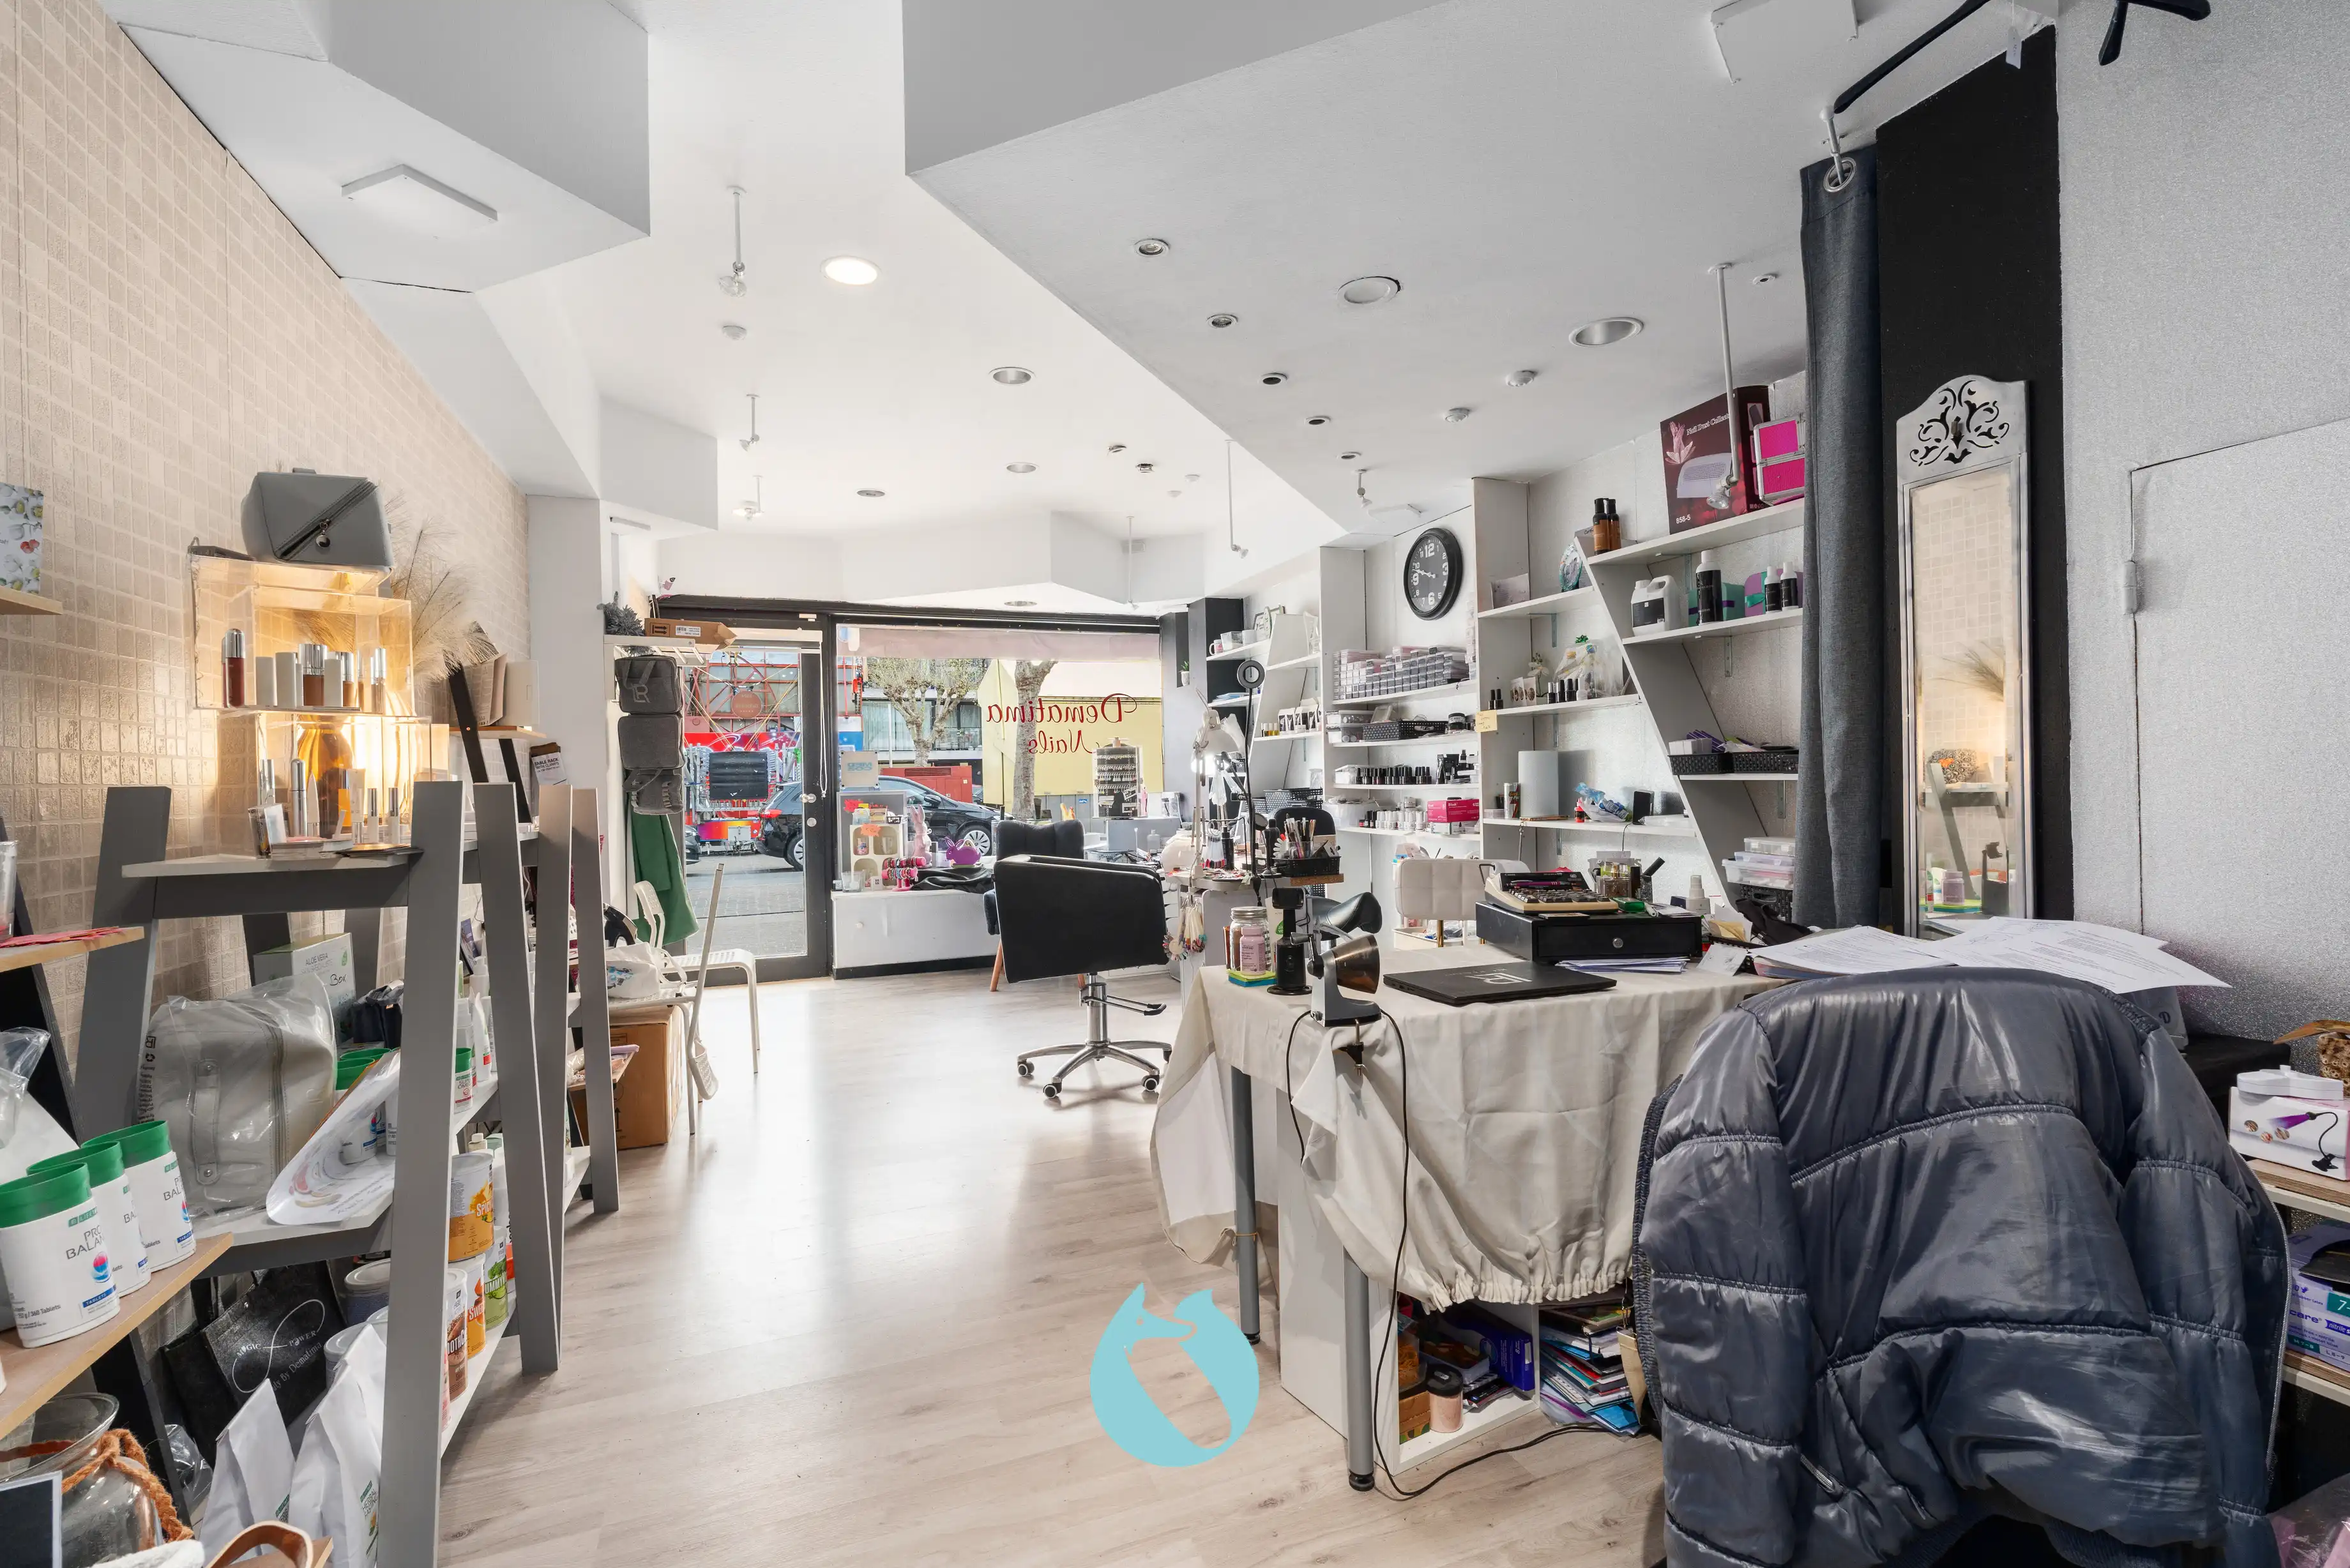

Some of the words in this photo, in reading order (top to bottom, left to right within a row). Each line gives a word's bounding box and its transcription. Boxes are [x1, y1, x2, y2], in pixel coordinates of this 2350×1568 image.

[1687, 426, 1697, 435] Nail
[1697, 421, 1710, 431] Dust
[1676, 515, 1691, 524] 858-5
[1425, 543, 1435, 558] 12
[1442, 562, 1448, 575] 3
[1413, 573, 1419, 585] 9
[1428, 592, 1435, 605] 6
[306, 956, 317, 965] ALOE
[317, 953, 328, 961] VERA
[330, 974, 347, 986] Box
[41, 1304, 61, 1313] Tablets
[2329, 1323, 2346, 1332] nitrile
[280, 1373, 290, 1382] By
